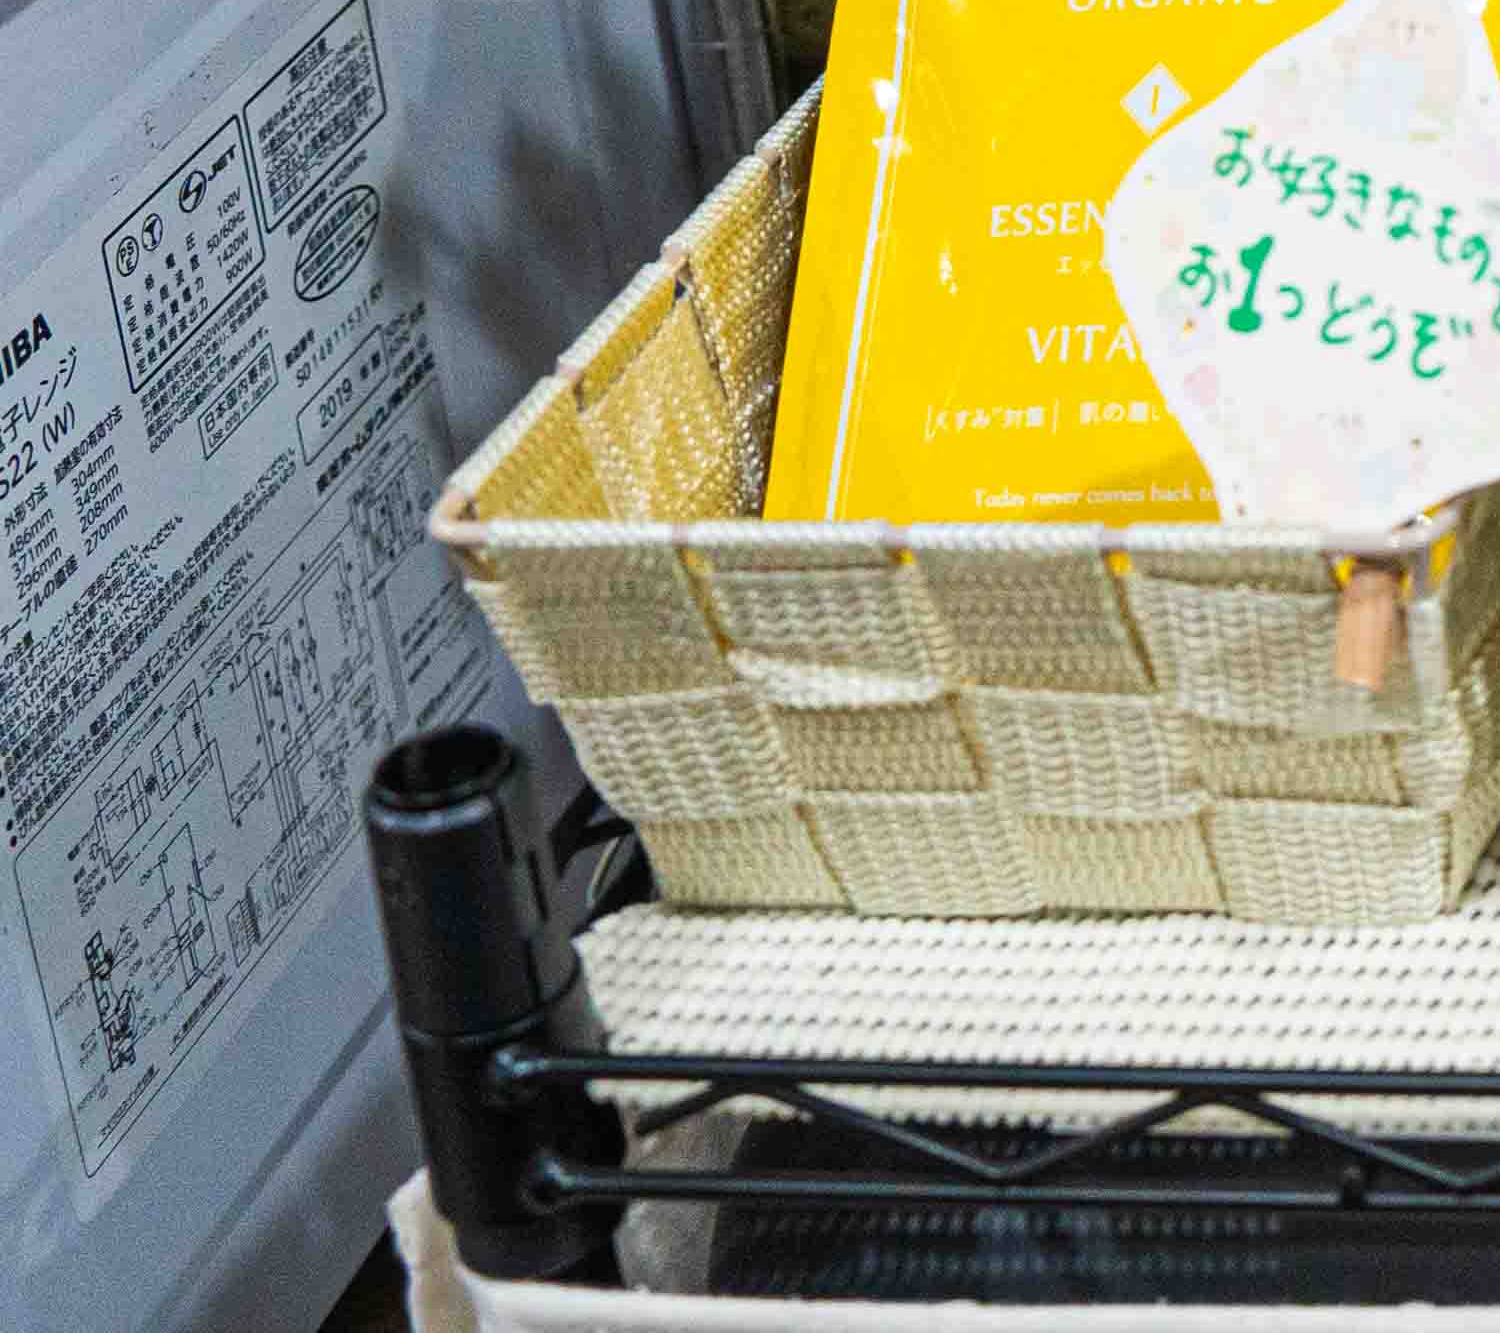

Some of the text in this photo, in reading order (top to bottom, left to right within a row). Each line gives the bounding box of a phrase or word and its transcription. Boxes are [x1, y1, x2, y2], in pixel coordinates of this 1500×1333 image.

[217, 187, 241, 218] 100V
[991, 201, 1112, 237] ESSEN
[207, 210, 246, 254] 50/60Hz
[217, 228, 249, 267] 1420W
[226, 248, 253, 284] 900W
[1178, 236, 1473, 379] お1つどうぞ
[1027, 325, 1137, 363] VITA
[319, 377, 352, 428] 2019
[71, 445, 114, 496] 304mm
[11, 463, 119, 581] 371mm 349mm
[17, 546, 62, 600] 296mm
[80, 482, 123, 533] 208mm
[84, 504, 128, 557] 270mm
